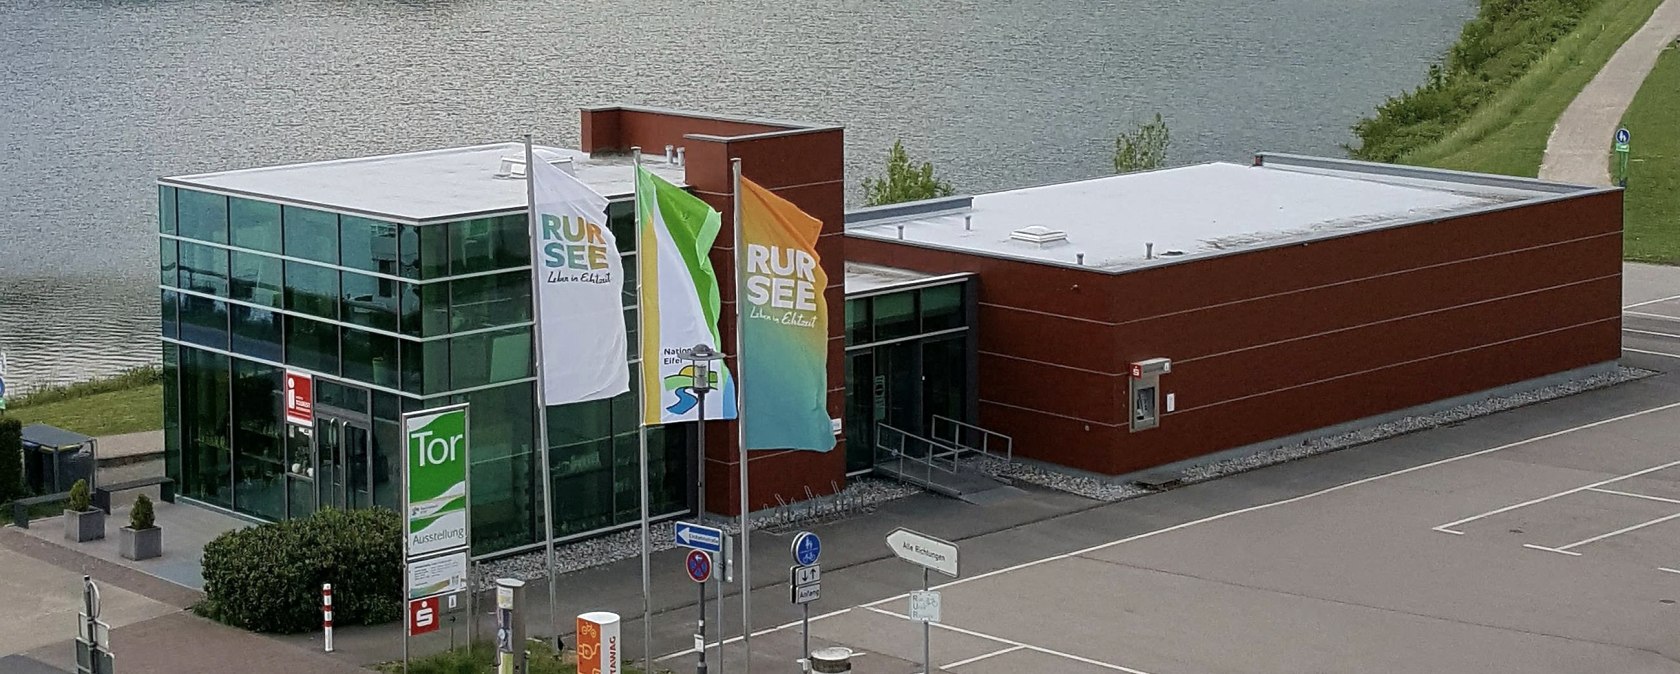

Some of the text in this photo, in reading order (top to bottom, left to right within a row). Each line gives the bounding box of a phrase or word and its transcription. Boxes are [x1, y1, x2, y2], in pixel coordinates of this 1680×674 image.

[541, 213, 607, 245] RUR
[544, 242, 609, 271] SEE
[747, 243, 816, 283] RUR
[747, 275, 816, 311] SEE
[411, 431, 464, 467] Tor
[413, 527, 465, 546] Ausstellung
[902, 541, 945, 561] Alle Richtungen
[800, 589, 819, 598] Anfang
